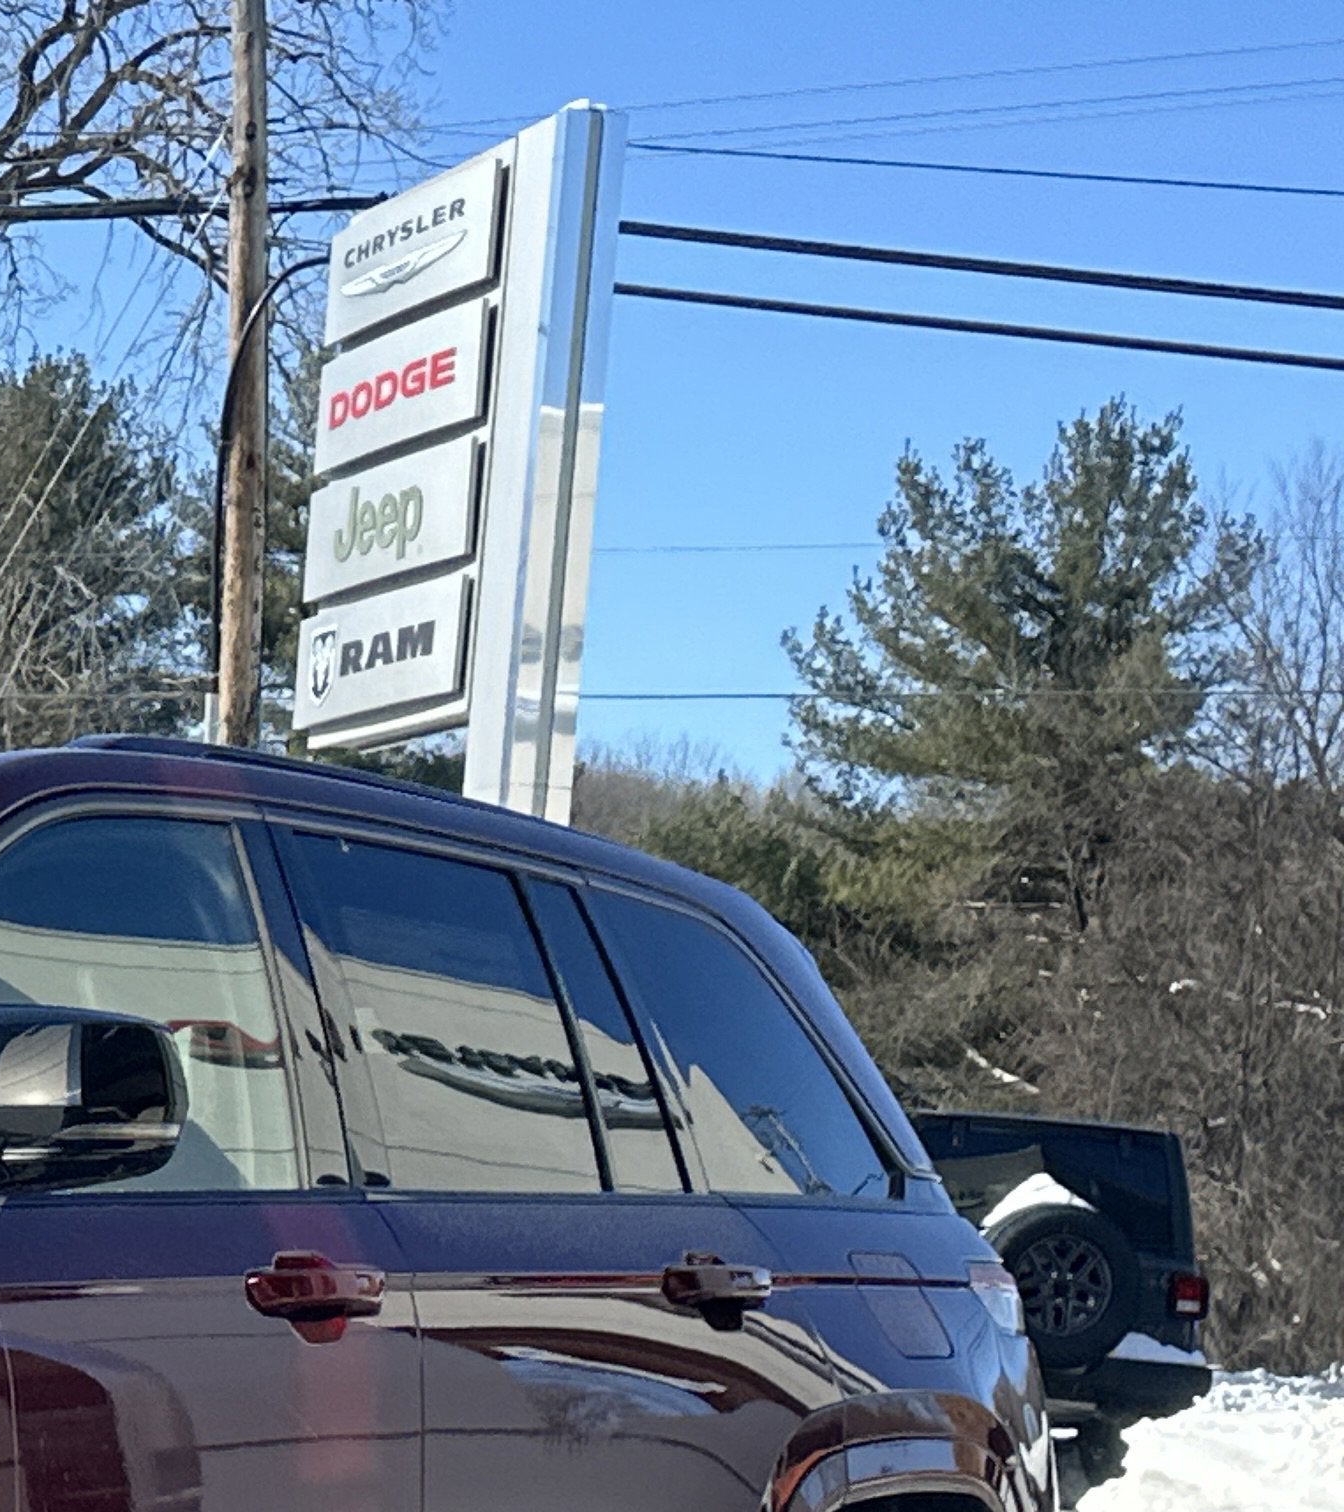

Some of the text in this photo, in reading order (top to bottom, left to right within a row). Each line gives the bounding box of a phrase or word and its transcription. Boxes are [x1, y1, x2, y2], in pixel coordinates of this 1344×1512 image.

[343, 198, 467, 269] CHRYSLER
[328, 346, 458, 431] DODGE
[333, 485, 423, 563] Jeep
[340, 619, 436, 677] RAM
